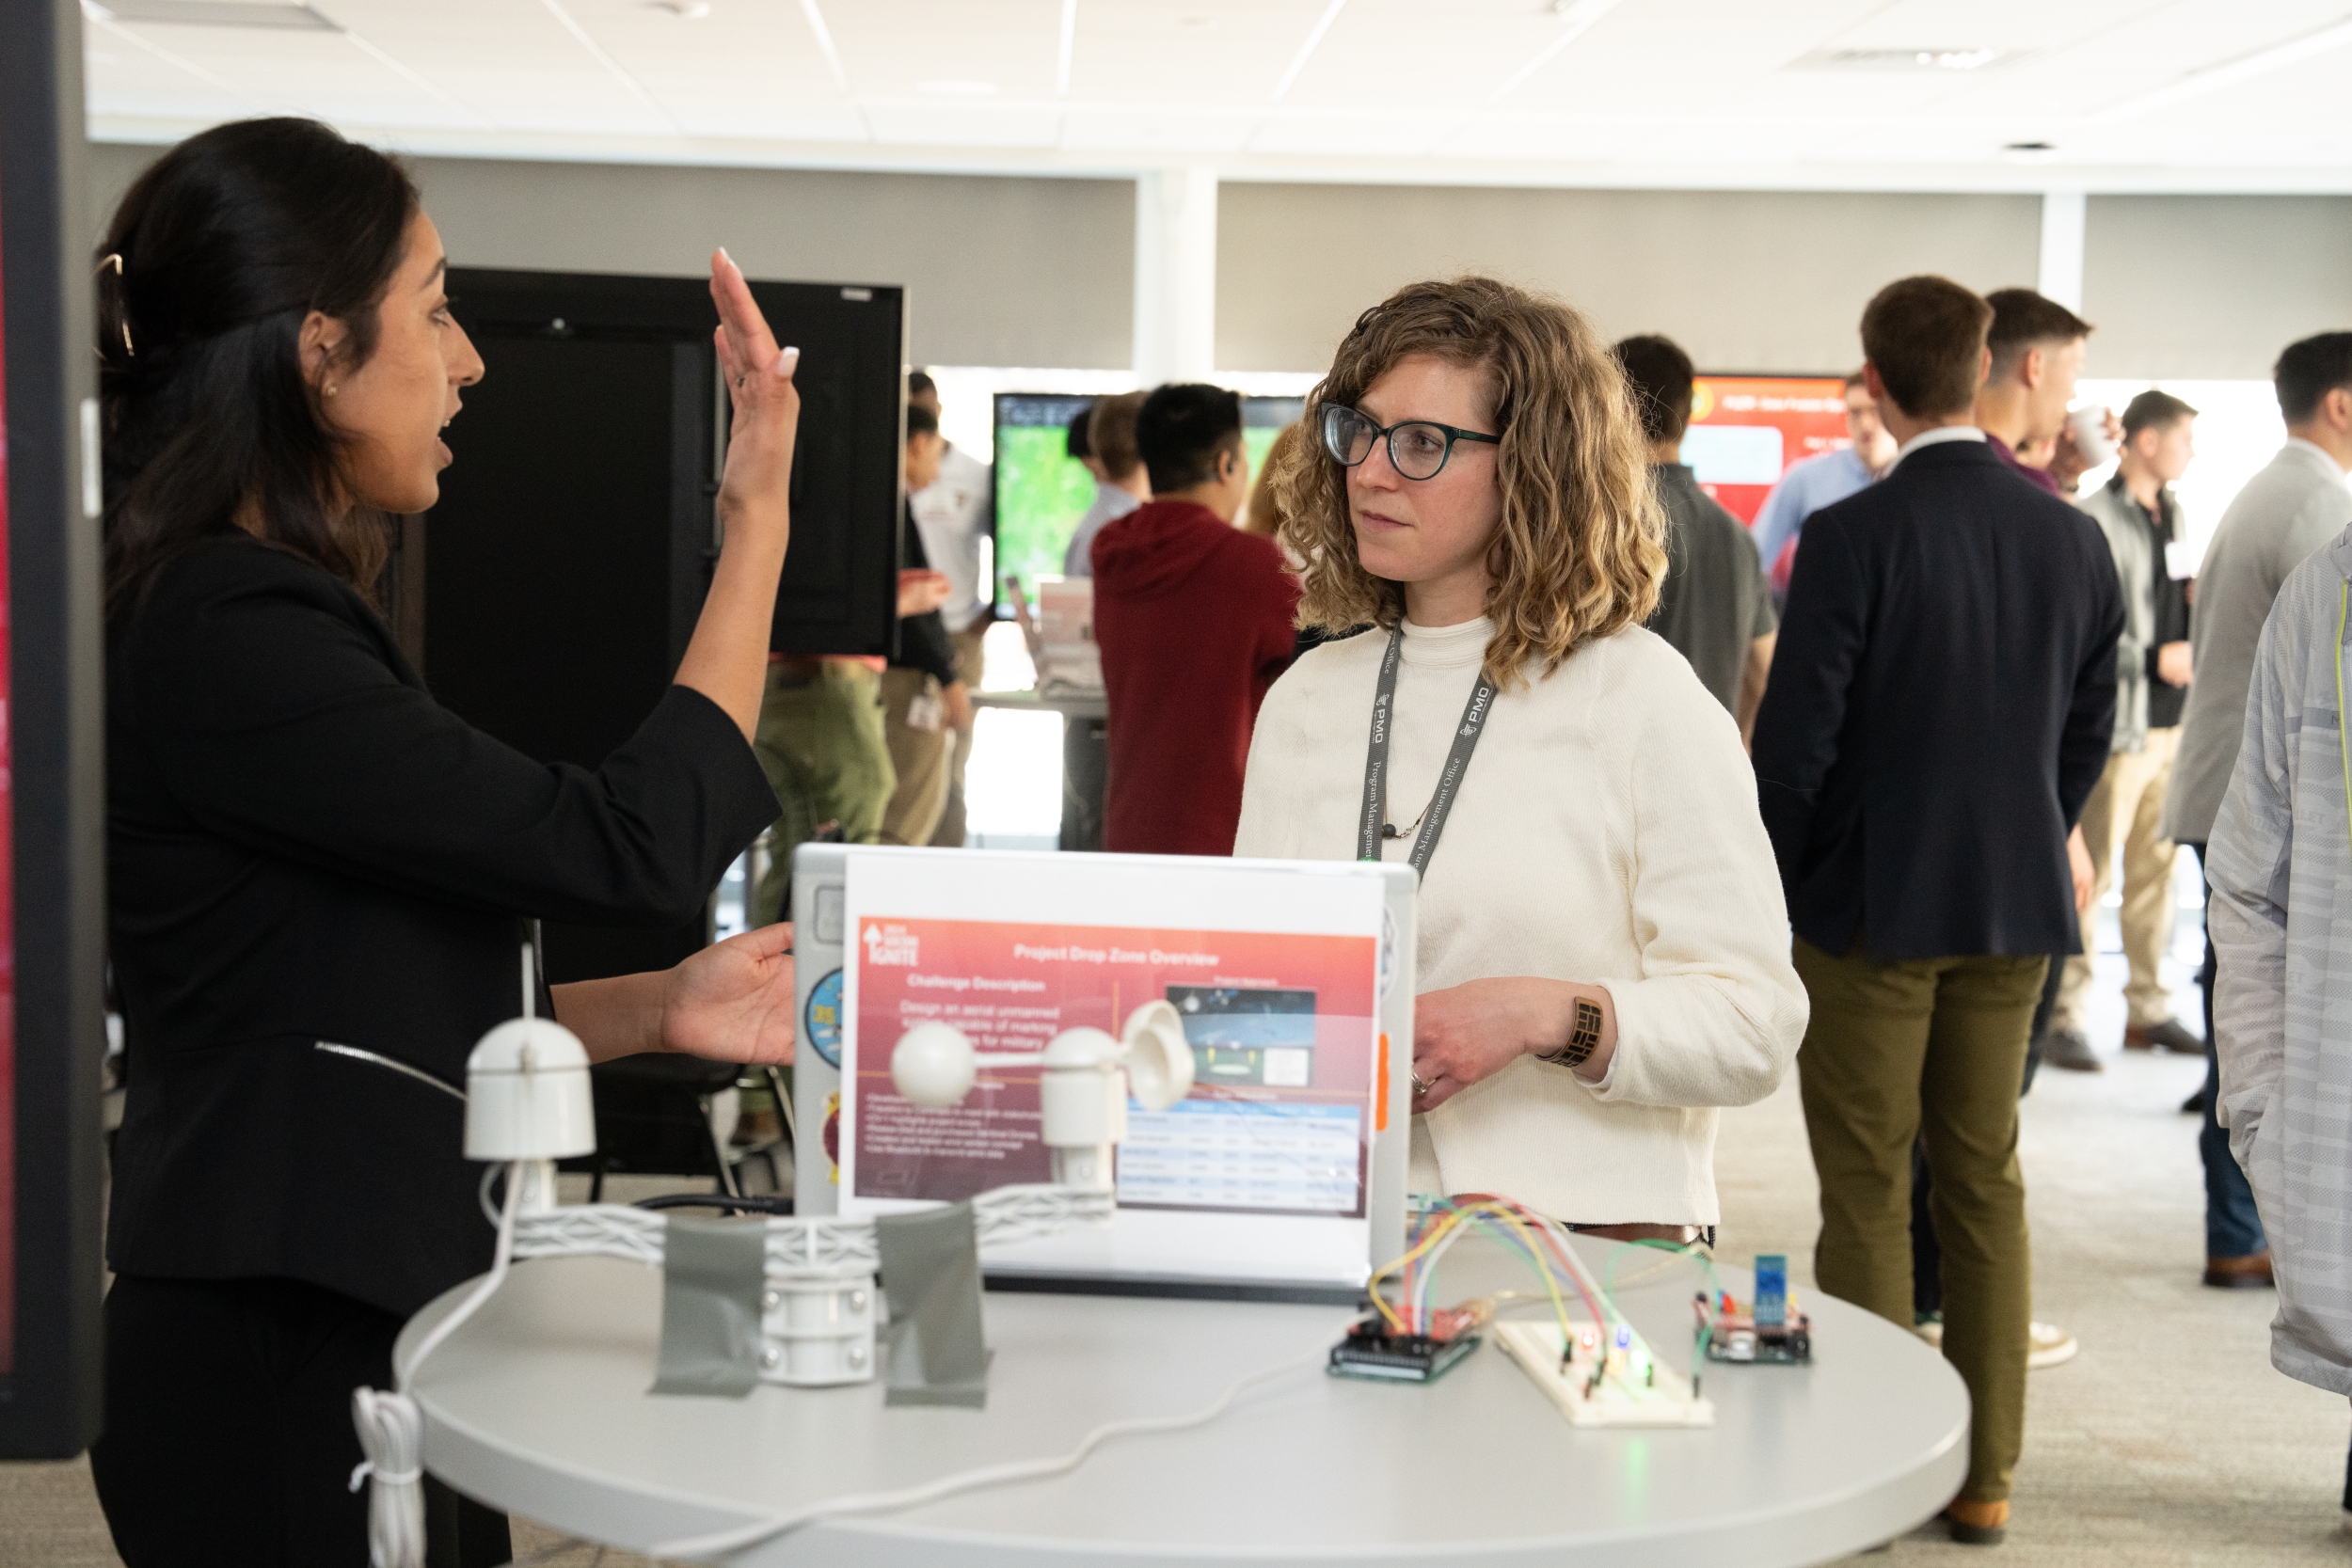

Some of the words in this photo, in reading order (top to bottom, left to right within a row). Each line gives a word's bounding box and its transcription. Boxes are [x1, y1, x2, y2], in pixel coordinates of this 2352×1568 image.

[1385, 647, 1395, 674] Office
[1469, 687, 1489, 722] PMO
[1375, 708, 1386, 744] PMO
[1368, 760, 1382, 801] Program
[1418, 788, 1449, 851] Management
[1443, 757, 1461, 787] Office
[1014, 943, 1067, 962] Project
[1069, 945, 1107, 964] Drop
[1108, 946, 1147, 964] Zone
[1149, 948, 1220, 967] Overview
[906, 973, 971, 991] Challenge
[972, 974, 1047, 993] Description
